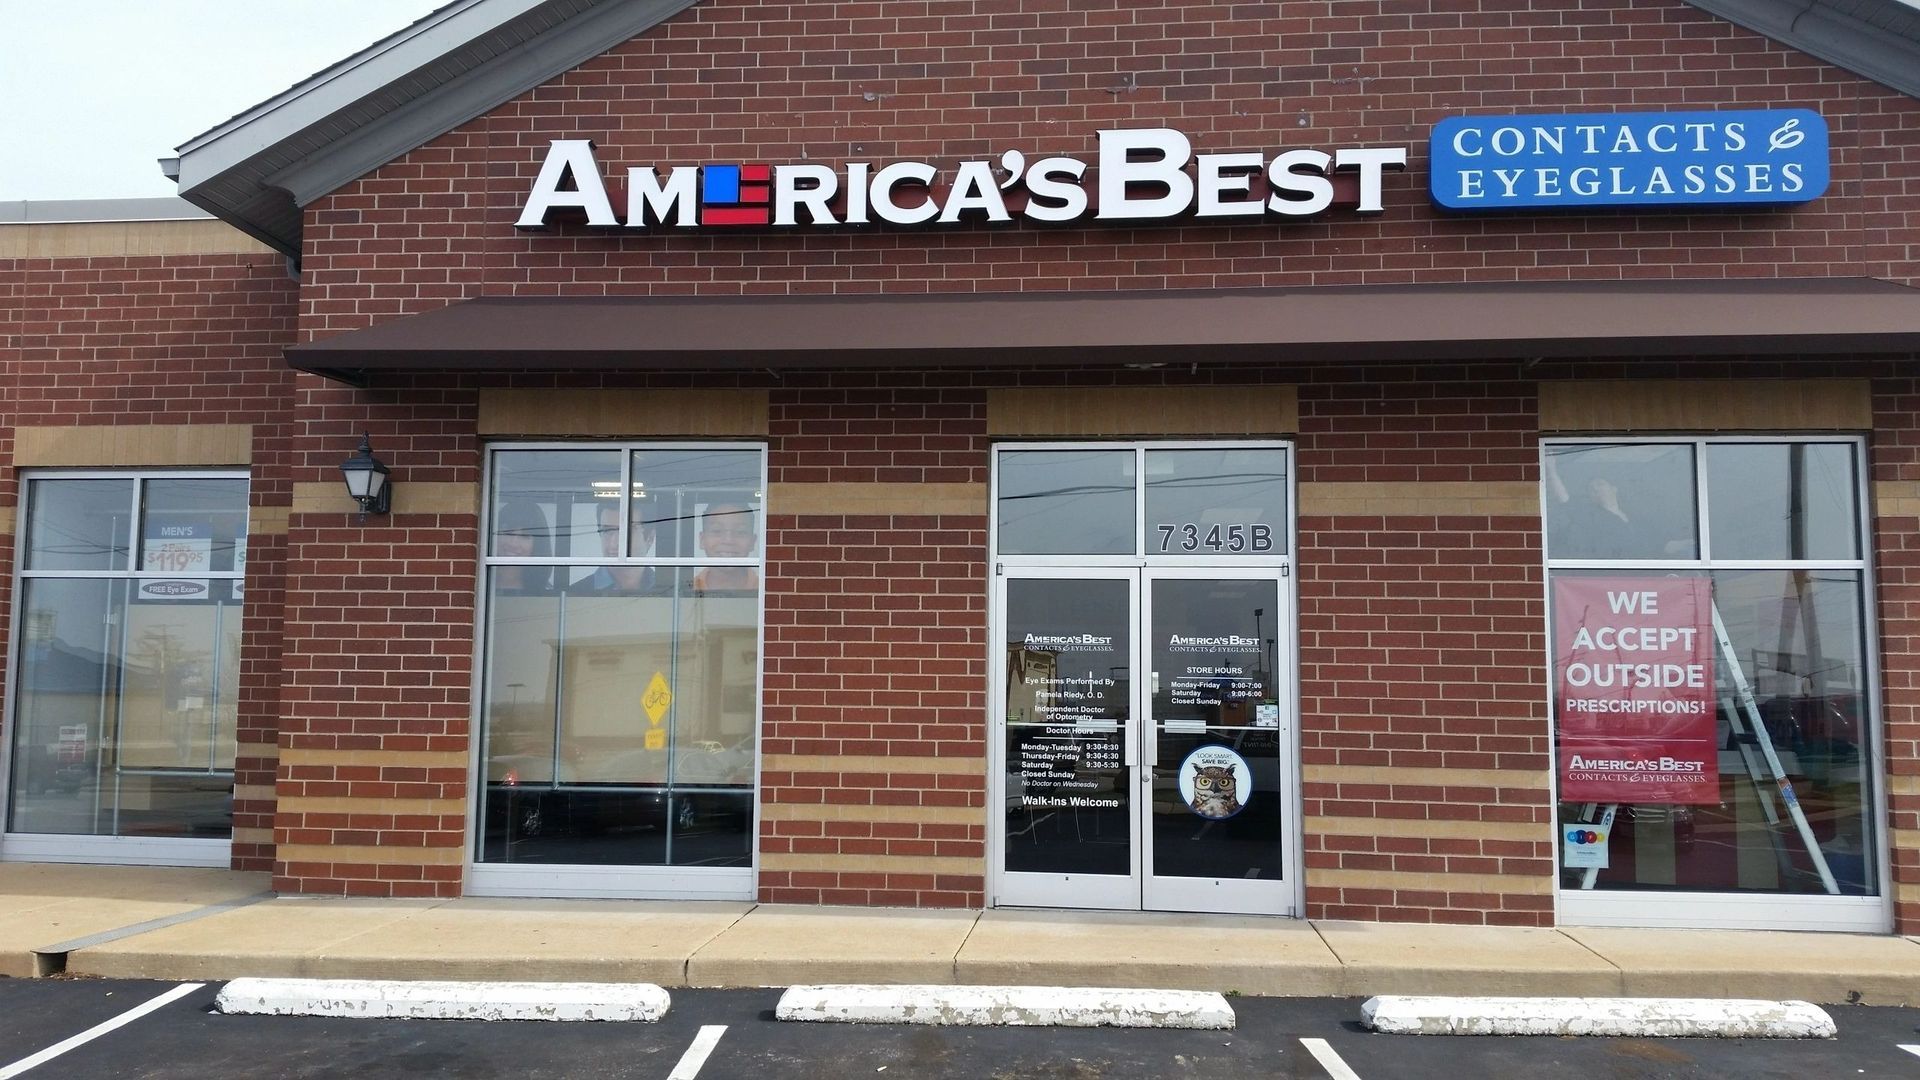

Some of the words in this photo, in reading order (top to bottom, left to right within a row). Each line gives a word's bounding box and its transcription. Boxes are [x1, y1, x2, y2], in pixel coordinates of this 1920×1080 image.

[1453, 122, 1746, 157] CONTACTS
[514, 139, 1088, 227] AMERICA'S
[1094, 128, 1407, 220] BEST
[1456, 163, 1804, 199] EYEGLASSES
[161, 526, 193, 536] MEN'S
[1157, 523, 1274, 553] 7345B
[161, 544, 167, 552] 2
[168, 544, 192, 552] Pairs
[167, 586, 179, 595] Eye
[1607, 591, 1658, 614] WE
[1024, 633, 1081, 644] AMERICA'S
[1082, 634, 1112, 644] BEST
[1170, 634, 1229, 645] AMERICA'S
[1229, 636, 1260, 645] BEST
[1572, 627, 1697, 651] ACCEPT
[1566, 663, 1705, 688] OUTSIDE
[1025, 677, 1039, 685] Eye
[1196, 698, 1221, 706] Sunday
[1566, 699, 1706, 714] PRESCRIPTIONS!
[1034, 706, 1079, 714] Independent
[1021, 743, 1081, 752] Monday-Tuesday
[1086, 743, 1119, 751] 9:30-6:30
[1021, 752, 1080, 761] Thursday-Friday
[1086, 752, 1119, 760] 9:30-6:30
[1021, 761, 1053, 769] Saturday
[1569, 755, 1658, 770] AMERICA'S
[1659, 757, 1704, 771] BEST
[1048, 771, 1075, 779] Sunday
[1569, 773, 1628, 782] CONTACTS
[1643, 774, 1706, 783] EYEGLASSES
[1062, 780, 1098, 789] Wednesday
[1022, 796, 1067, 806] Walk-Ins
[1069, 796, 1119, 807] Welcome
